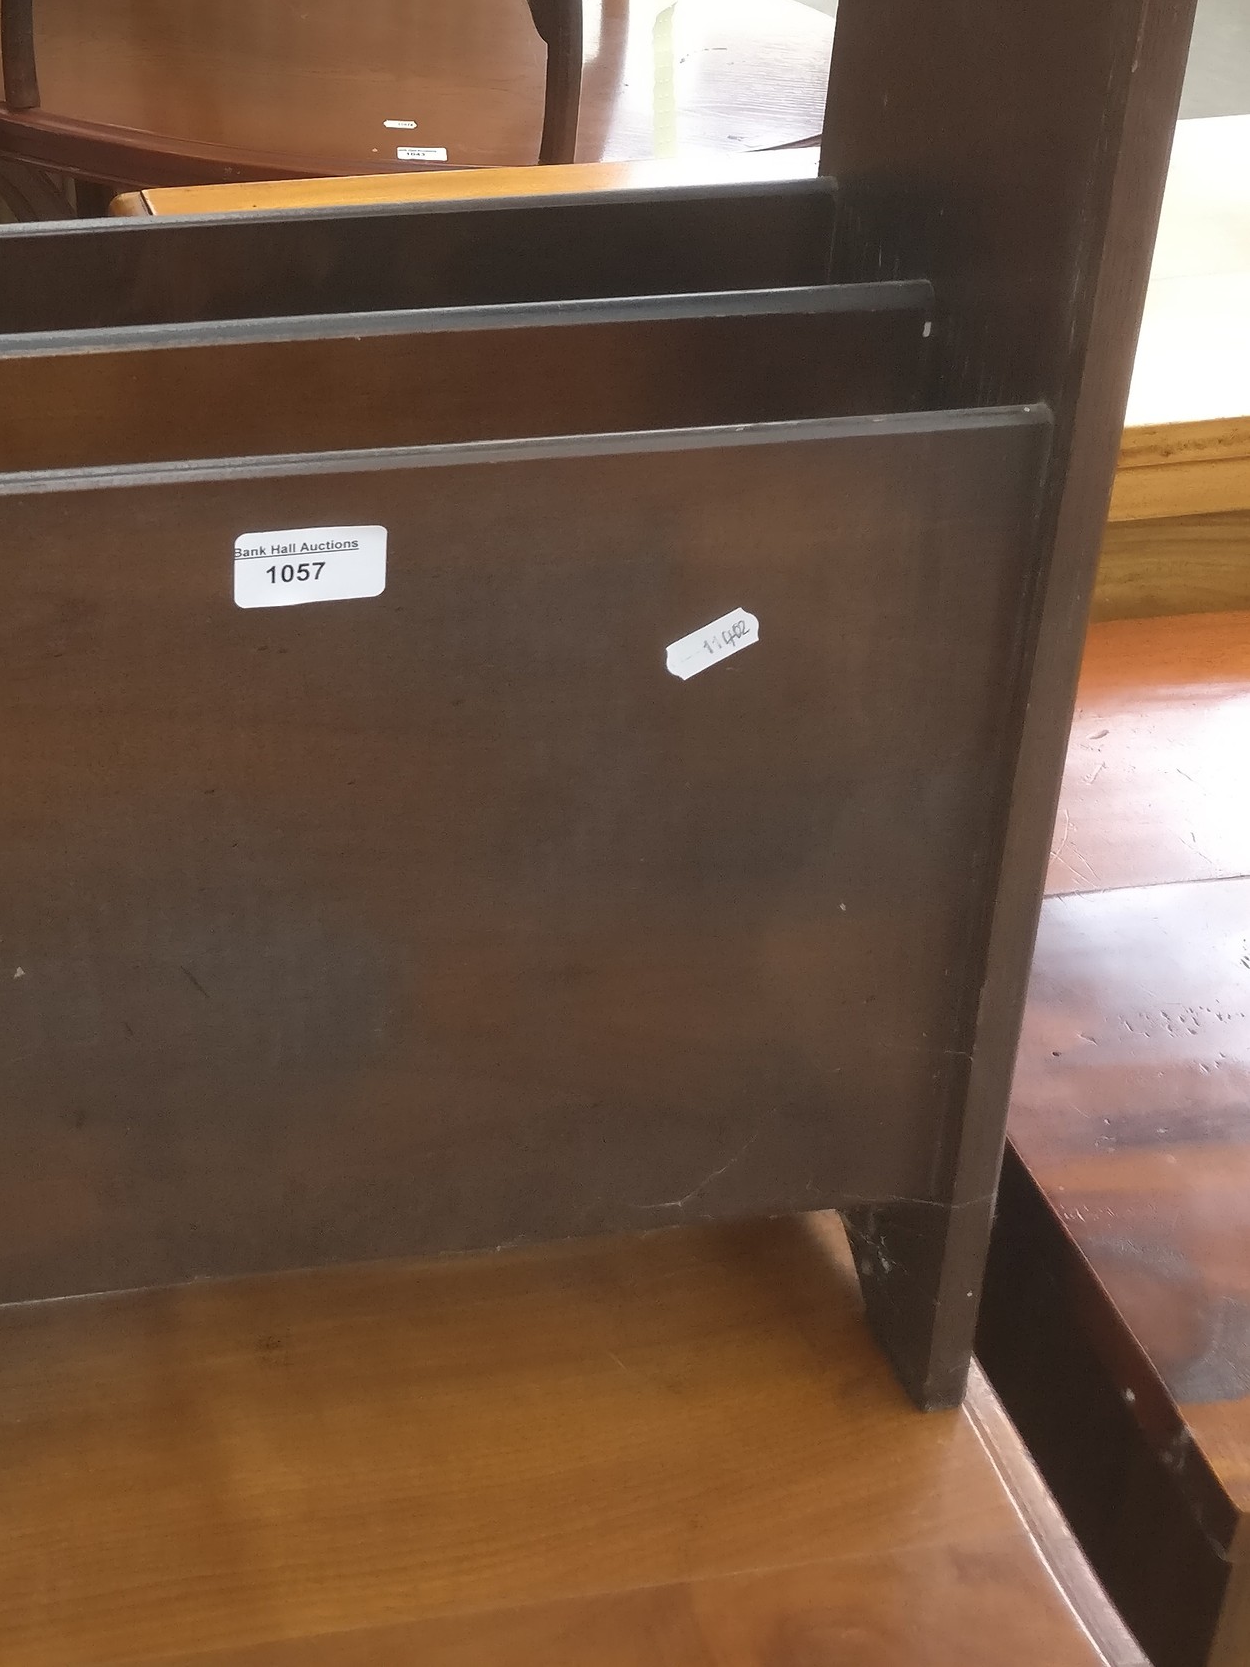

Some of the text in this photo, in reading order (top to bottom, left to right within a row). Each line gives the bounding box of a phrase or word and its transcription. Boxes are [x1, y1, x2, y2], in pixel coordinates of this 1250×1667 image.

[234, 539, 359, 558] Bank Hall Auctions
[266, 561, 326, 584] 1057
